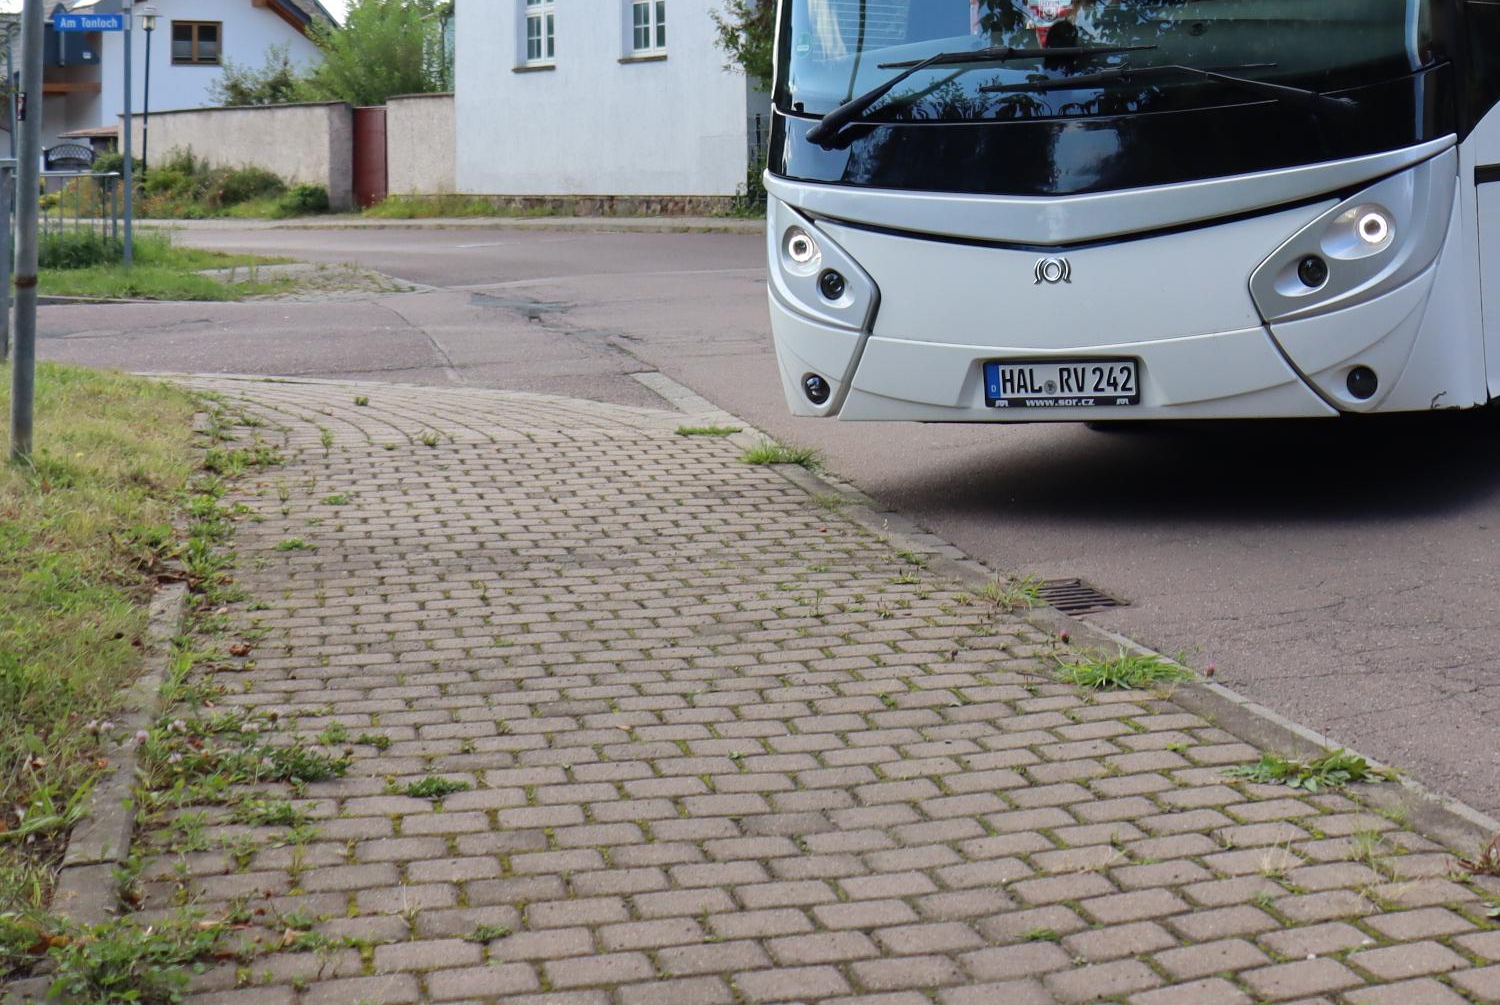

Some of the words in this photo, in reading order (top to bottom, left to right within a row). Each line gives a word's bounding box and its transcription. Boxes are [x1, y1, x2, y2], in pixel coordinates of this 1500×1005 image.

[61, 17, 76, 28] Am
[991, 385, 997, 393] D
[1001, 368, 1043, 394] HAL
[1059, 367, 1086, 393] RV
[1092, 366, 1133, 392] 242
[1026, 398, 1095, 407] www.sor.cz
